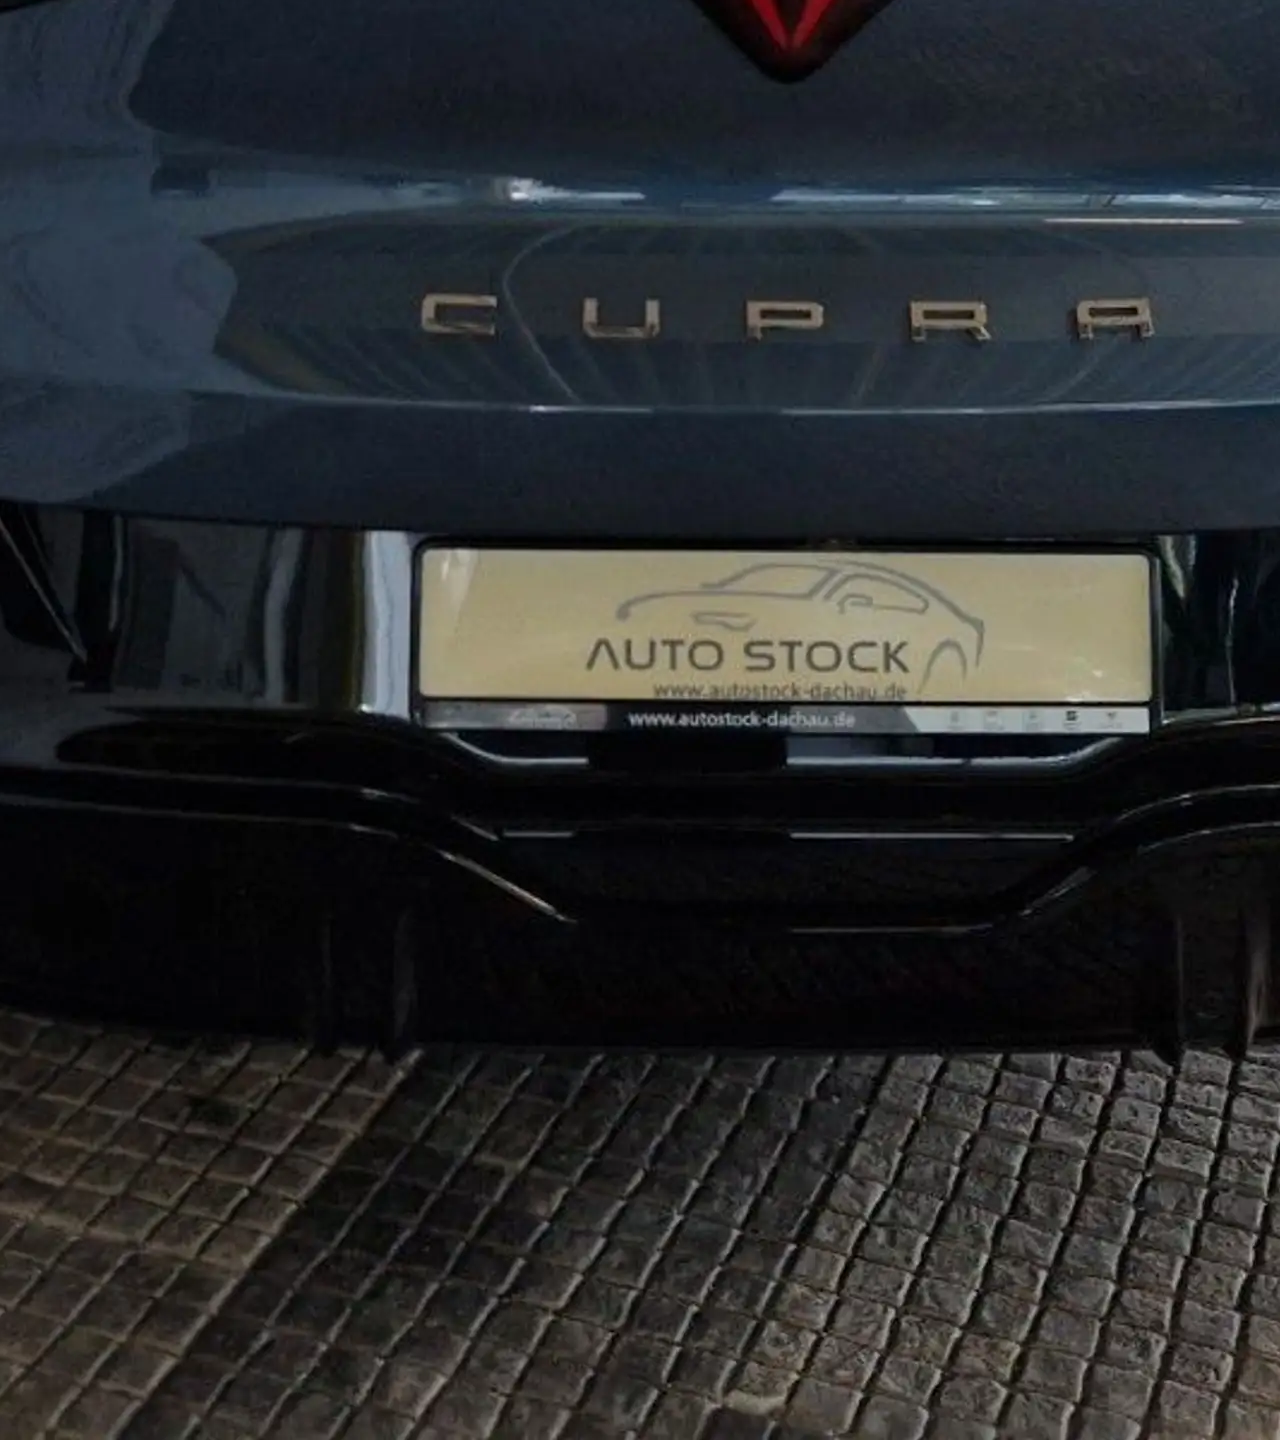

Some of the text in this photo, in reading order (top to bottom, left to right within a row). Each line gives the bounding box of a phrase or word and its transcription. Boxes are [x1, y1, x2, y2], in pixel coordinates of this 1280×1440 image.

[420, 293, 1153, 343] CUPRA
[586, 637, 911, 673] AUTO STOCK
[653, 681, 907, 702] www.autostock-dachau.de
[628, 709, 856, 729] www.autostock-dachau.de
